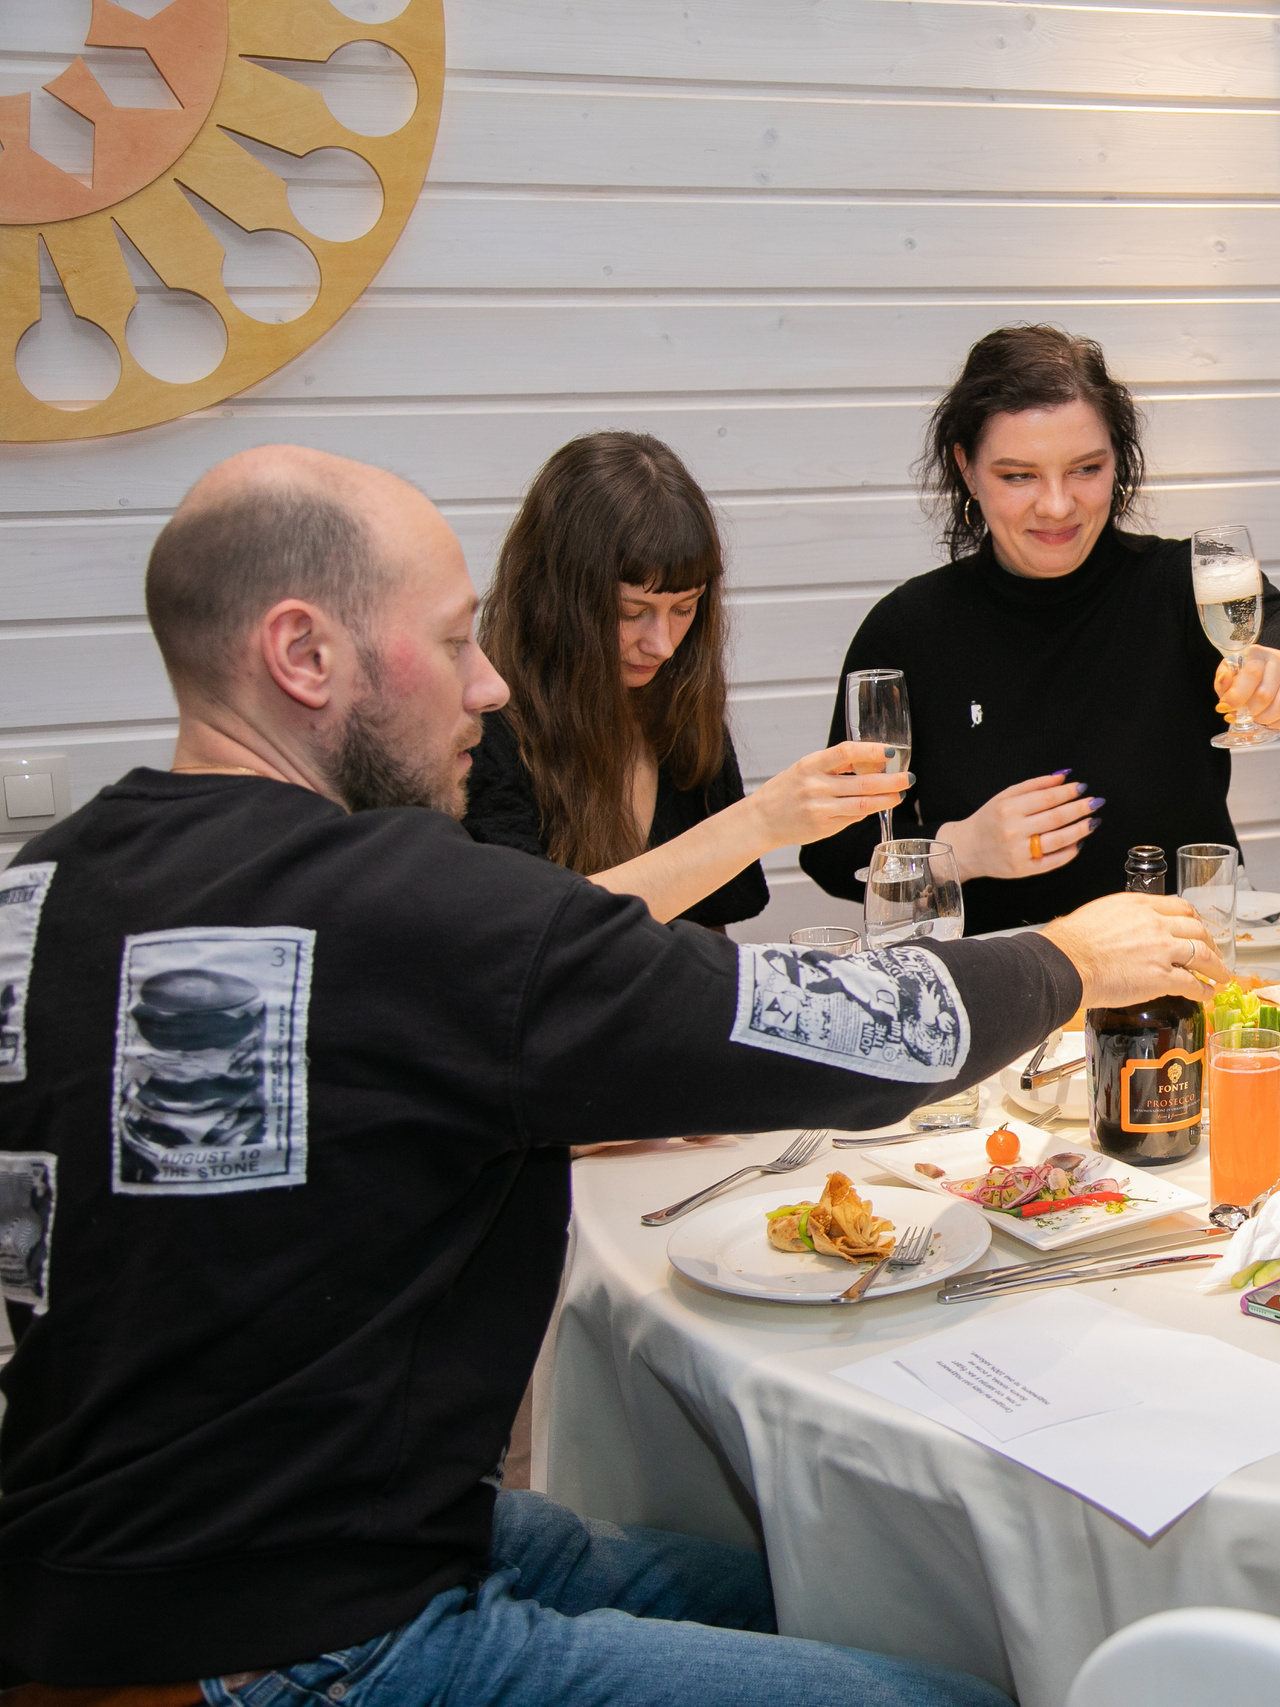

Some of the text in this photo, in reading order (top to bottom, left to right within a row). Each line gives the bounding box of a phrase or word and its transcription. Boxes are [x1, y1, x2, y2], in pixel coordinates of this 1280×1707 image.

[270, 946, 286, 968] 3
[861, 1025, 874, 1052] JOIN
[874, 1024, 887, 1048] THE
[887, 1021, 902, 1044] fun
[1158, 1081, 1189, 1094] FONTE
[1146, 1093, 1195, 1108] PROSECCO
[161, 1149, 261, 1164] AUGUST 10
[162, 1161, 259, 1178] THE STONE
